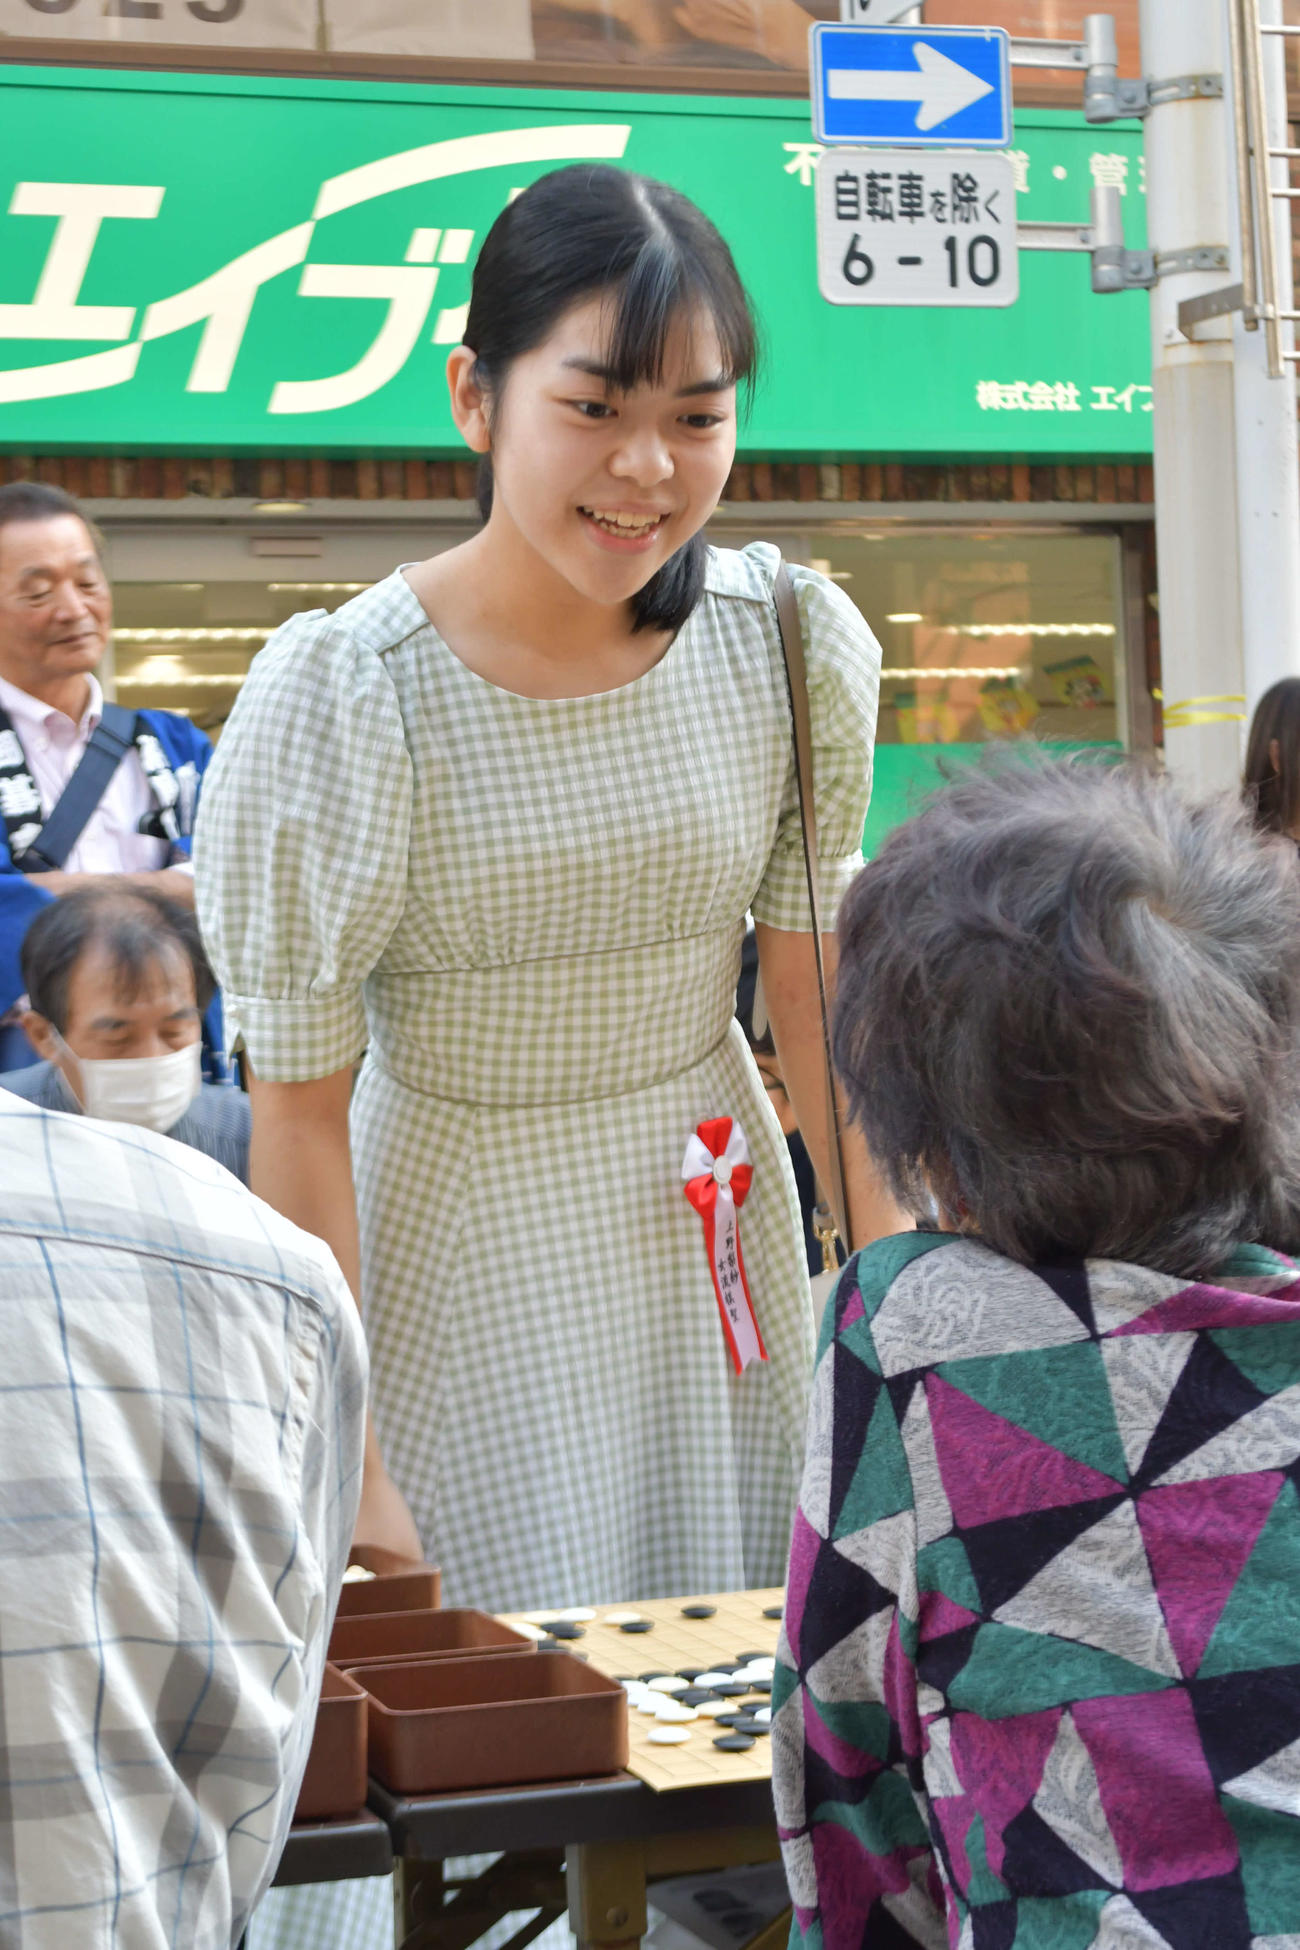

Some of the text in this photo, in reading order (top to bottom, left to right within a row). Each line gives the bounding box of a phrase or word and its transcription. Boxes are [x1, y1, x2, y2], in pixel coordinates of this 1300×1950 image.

[0, 124, 532, 415] エイブ
[835, 170, 1001, 224] 自転車を除く
